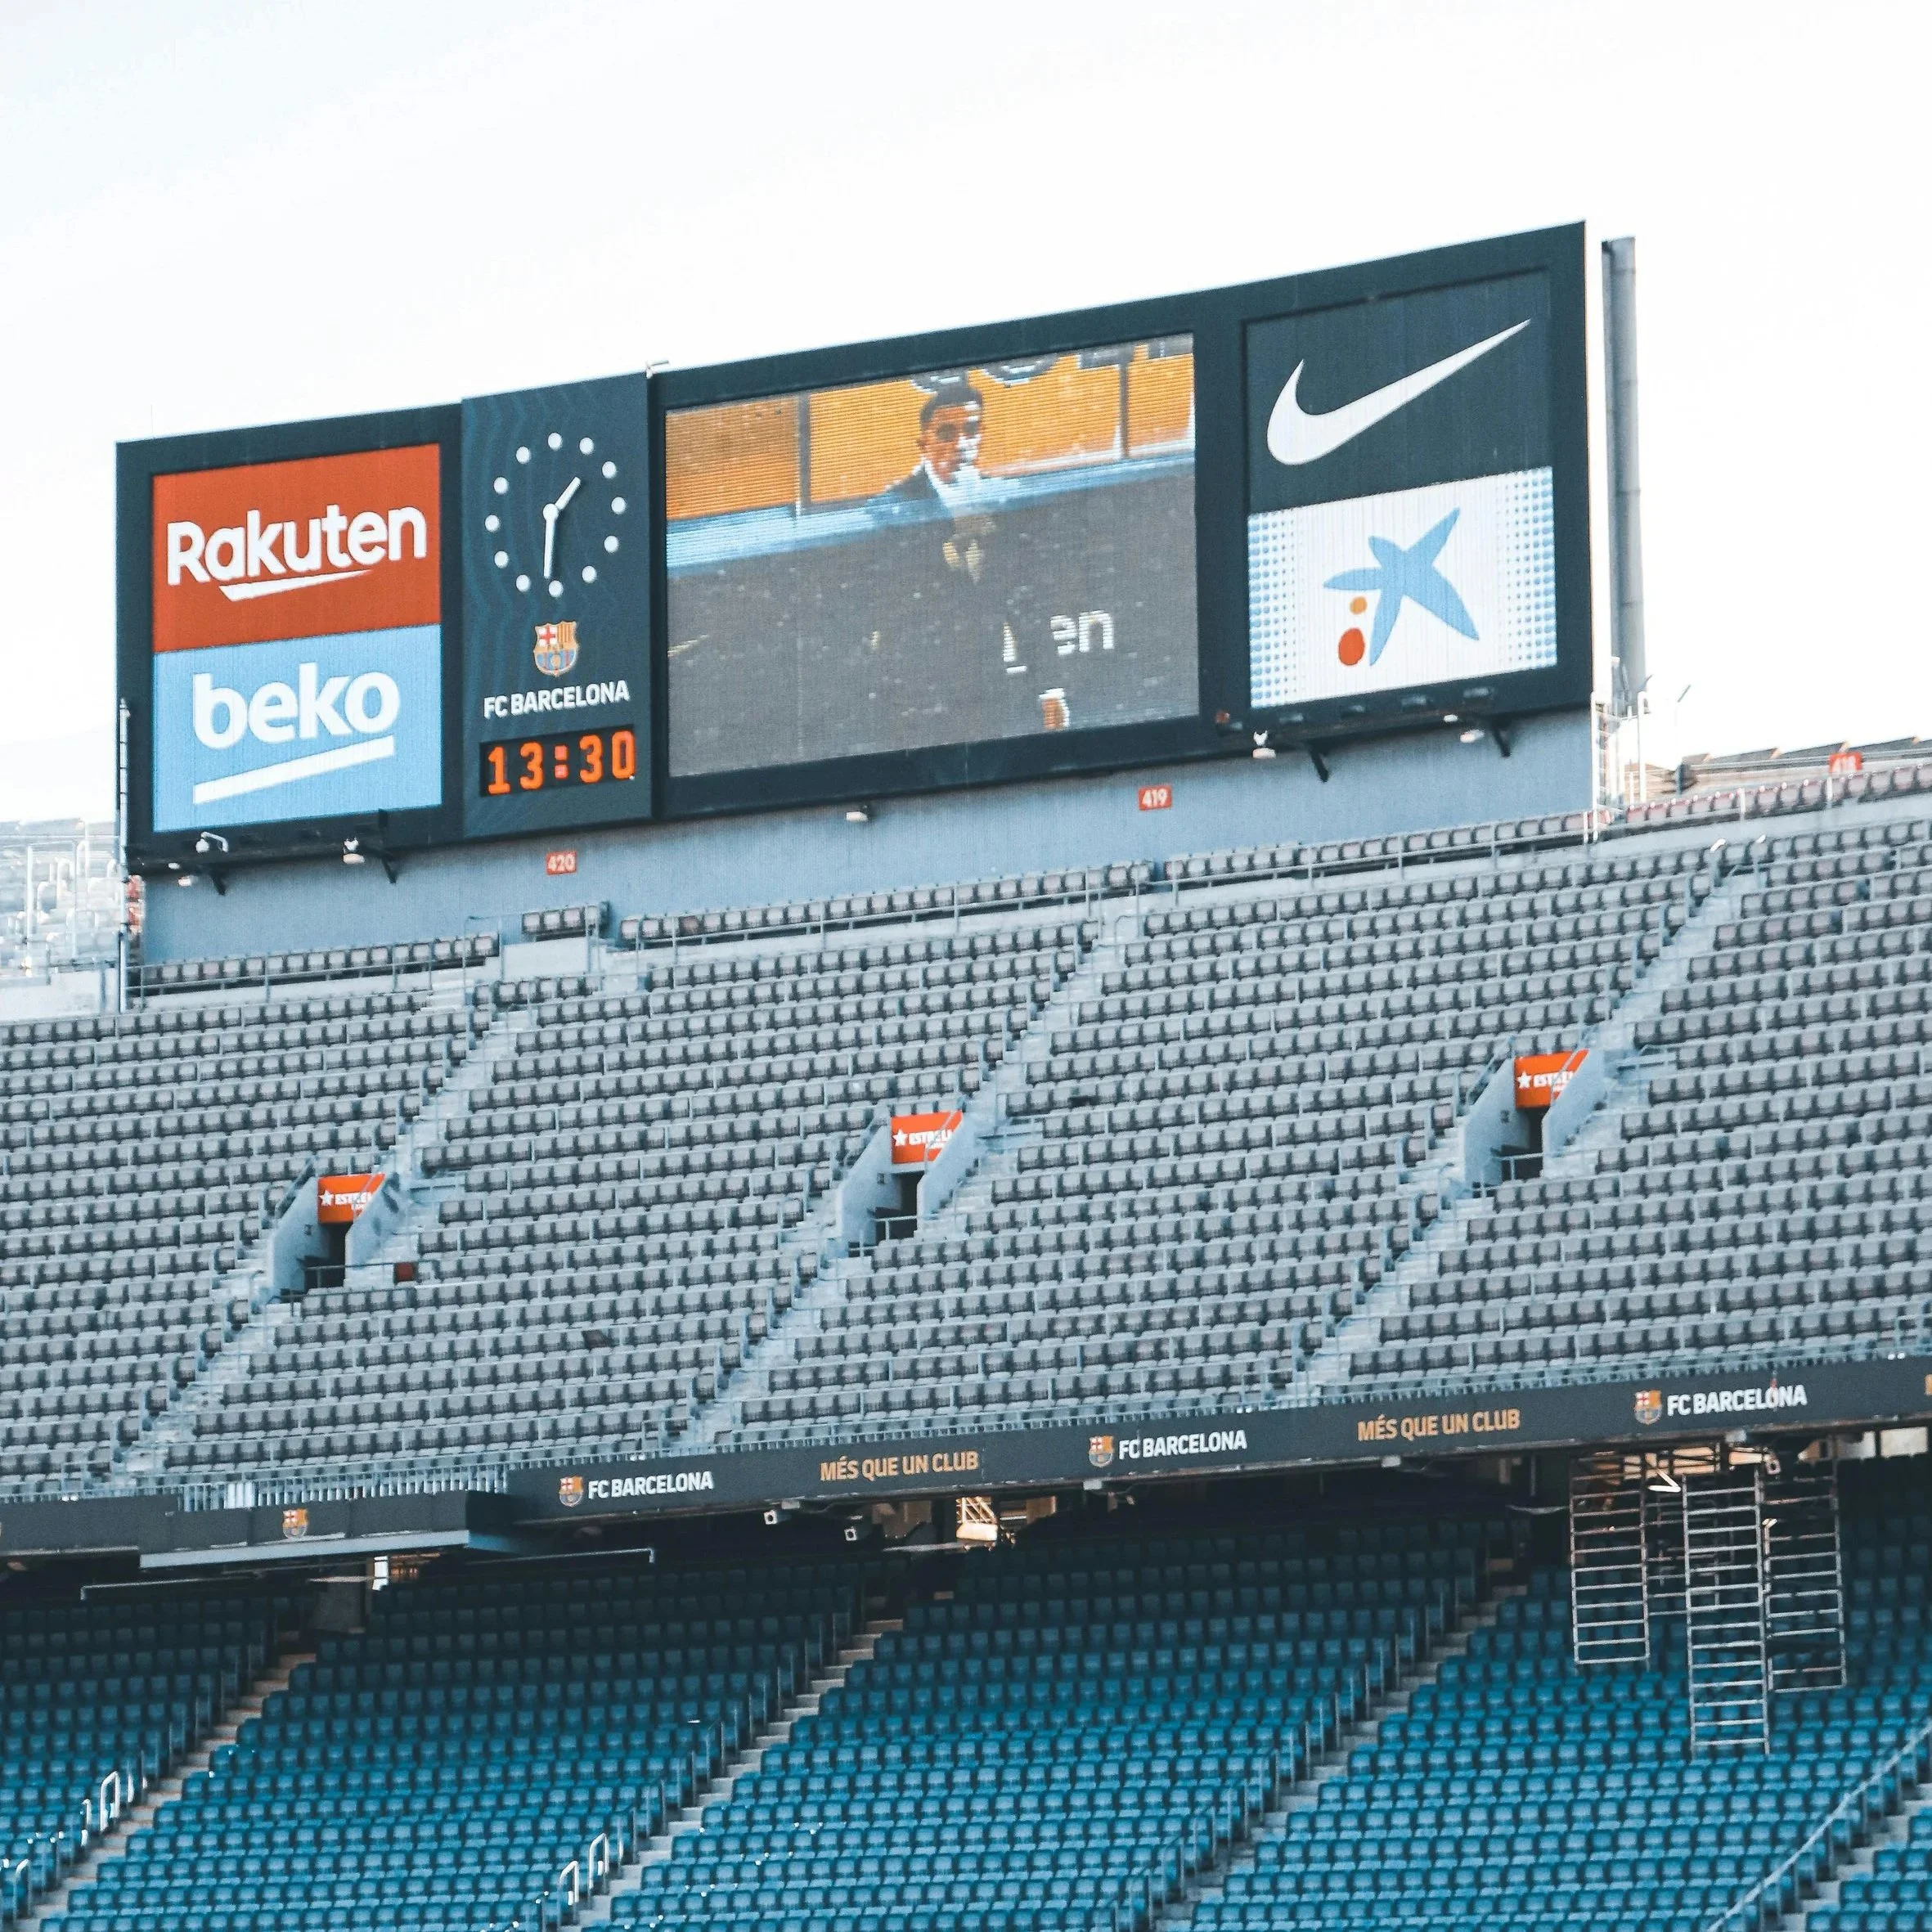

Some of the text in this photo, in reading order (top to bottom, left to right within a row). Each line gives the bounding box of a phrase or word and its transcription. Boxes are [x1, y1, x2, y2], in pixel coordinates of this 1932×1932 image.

[167, 504, 427, 586] Rakuten
[192, 662, 401, 750] beko
[483, 680, 631, 719] FC BARCELONA
[488, 730, 636, 795] 13:30
[1141, 788, 1167, 808] 419
[547, 852, 576, 871] 420
[1667, 1384, 1808, 1417] FC BARCELONA
[1358, 1409, 1521, 1442] MÉS QUE UN CLUB
[1119, 1430, 1247, 1460] FC BARCELONA
[820, 1450, 979, 1482] MÉS QUE UN CLUB
[588, 1471, 714, 1499] FC BARCELONA
